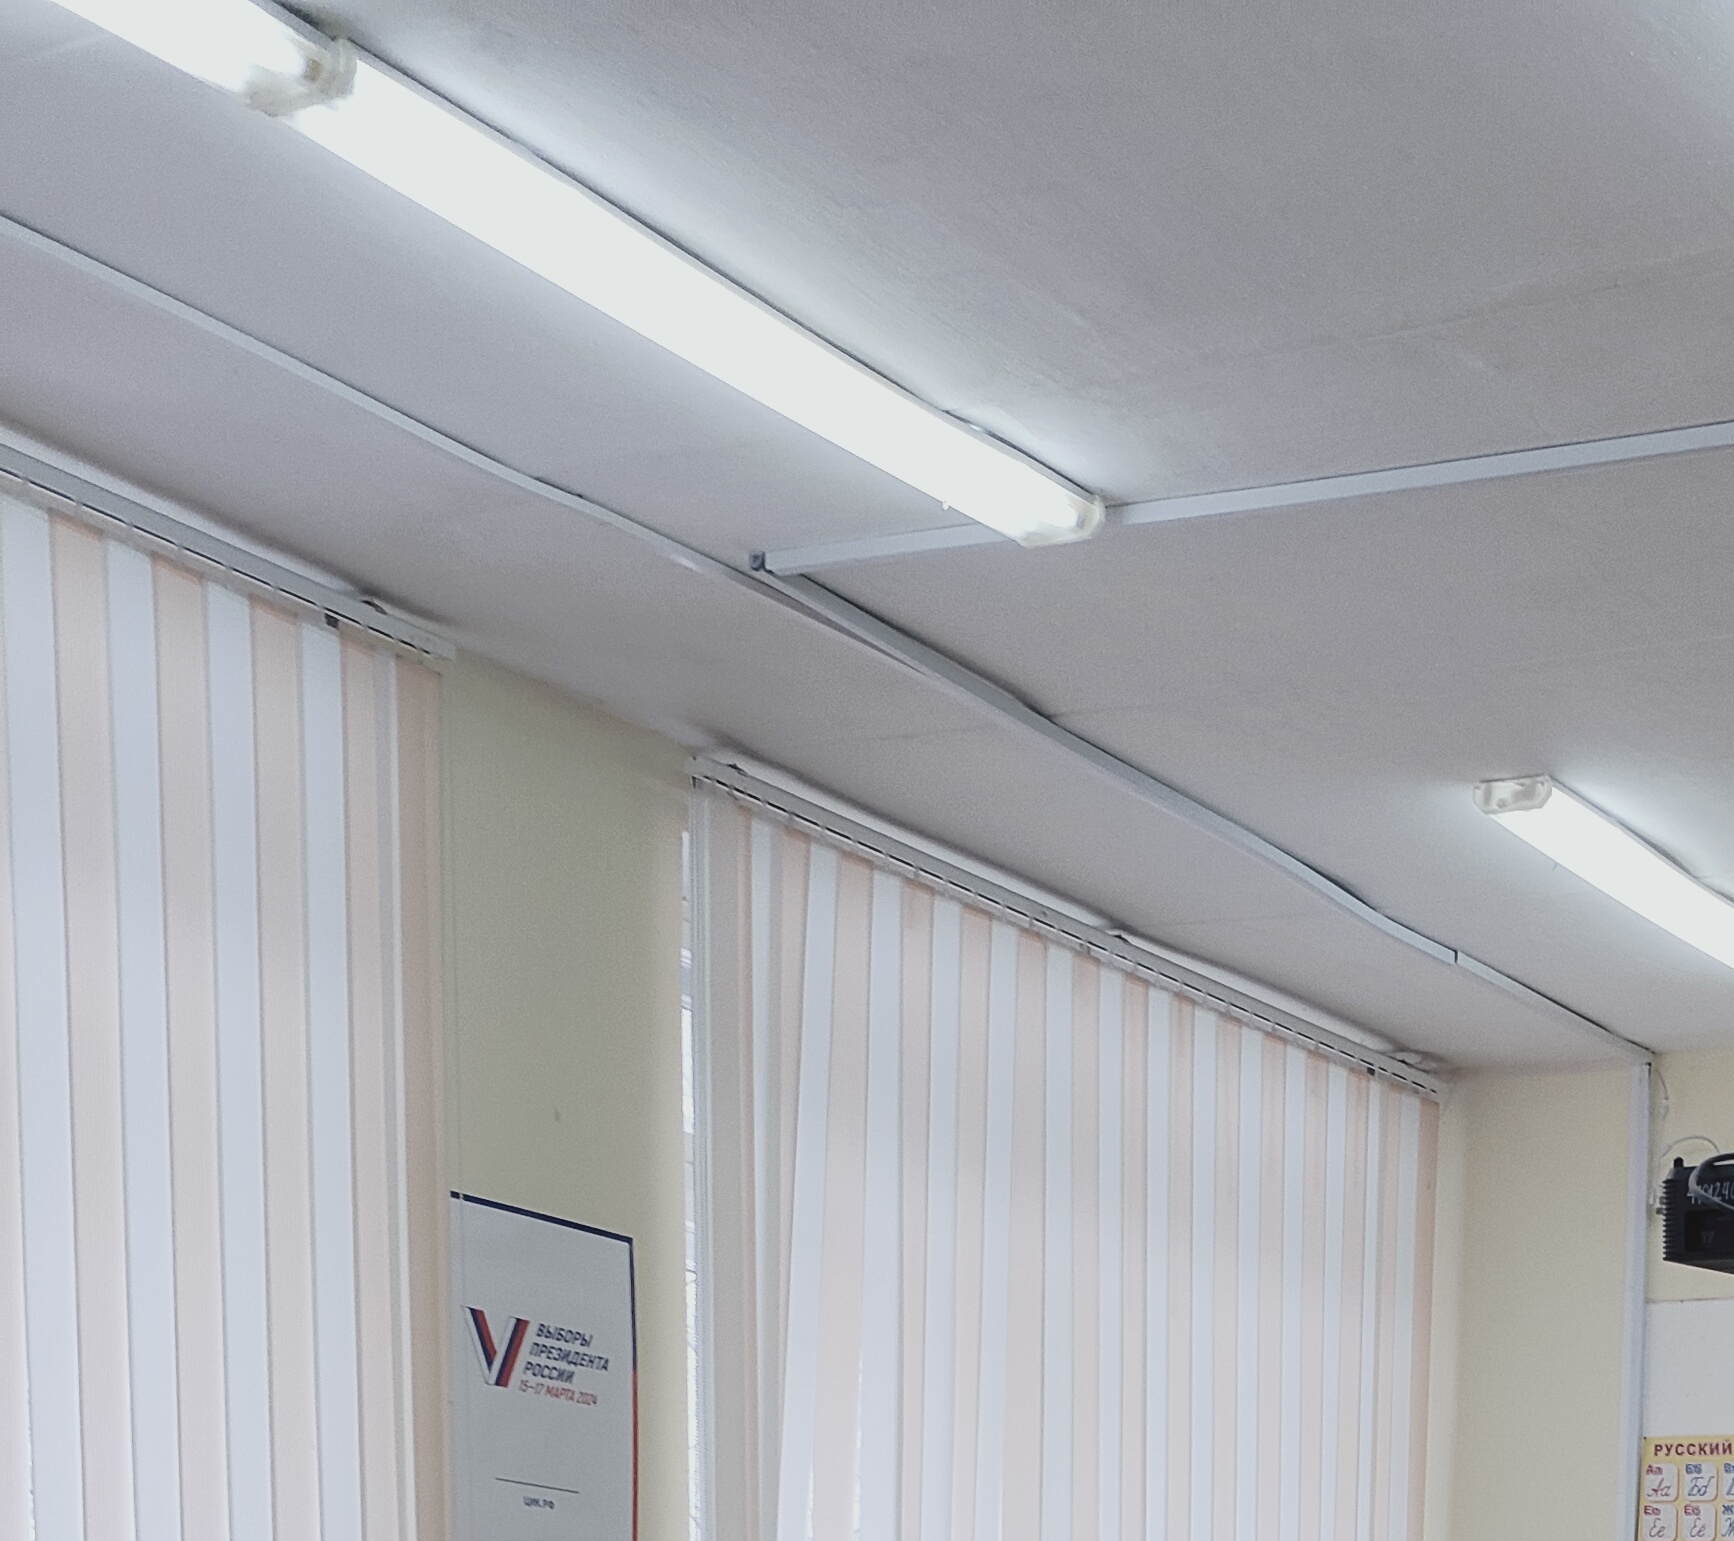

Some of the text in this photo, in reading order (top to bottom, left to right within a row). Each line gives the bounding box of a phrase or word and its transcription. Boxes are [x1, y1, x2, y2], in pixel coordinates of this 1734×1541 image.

[536, 1323, 593, 1348] ВЫБОРЫ
[529, 1342, 610, 1371] ПРЕЗИДЕНТА
[523, 1361, 575, 1384] РОССИИ
[545, 1386, 575, 1401] МАРТА
[576, 1393, 598, 1405] 2024
[1654, 1439, 1733, 1456] РУССКИЙ
